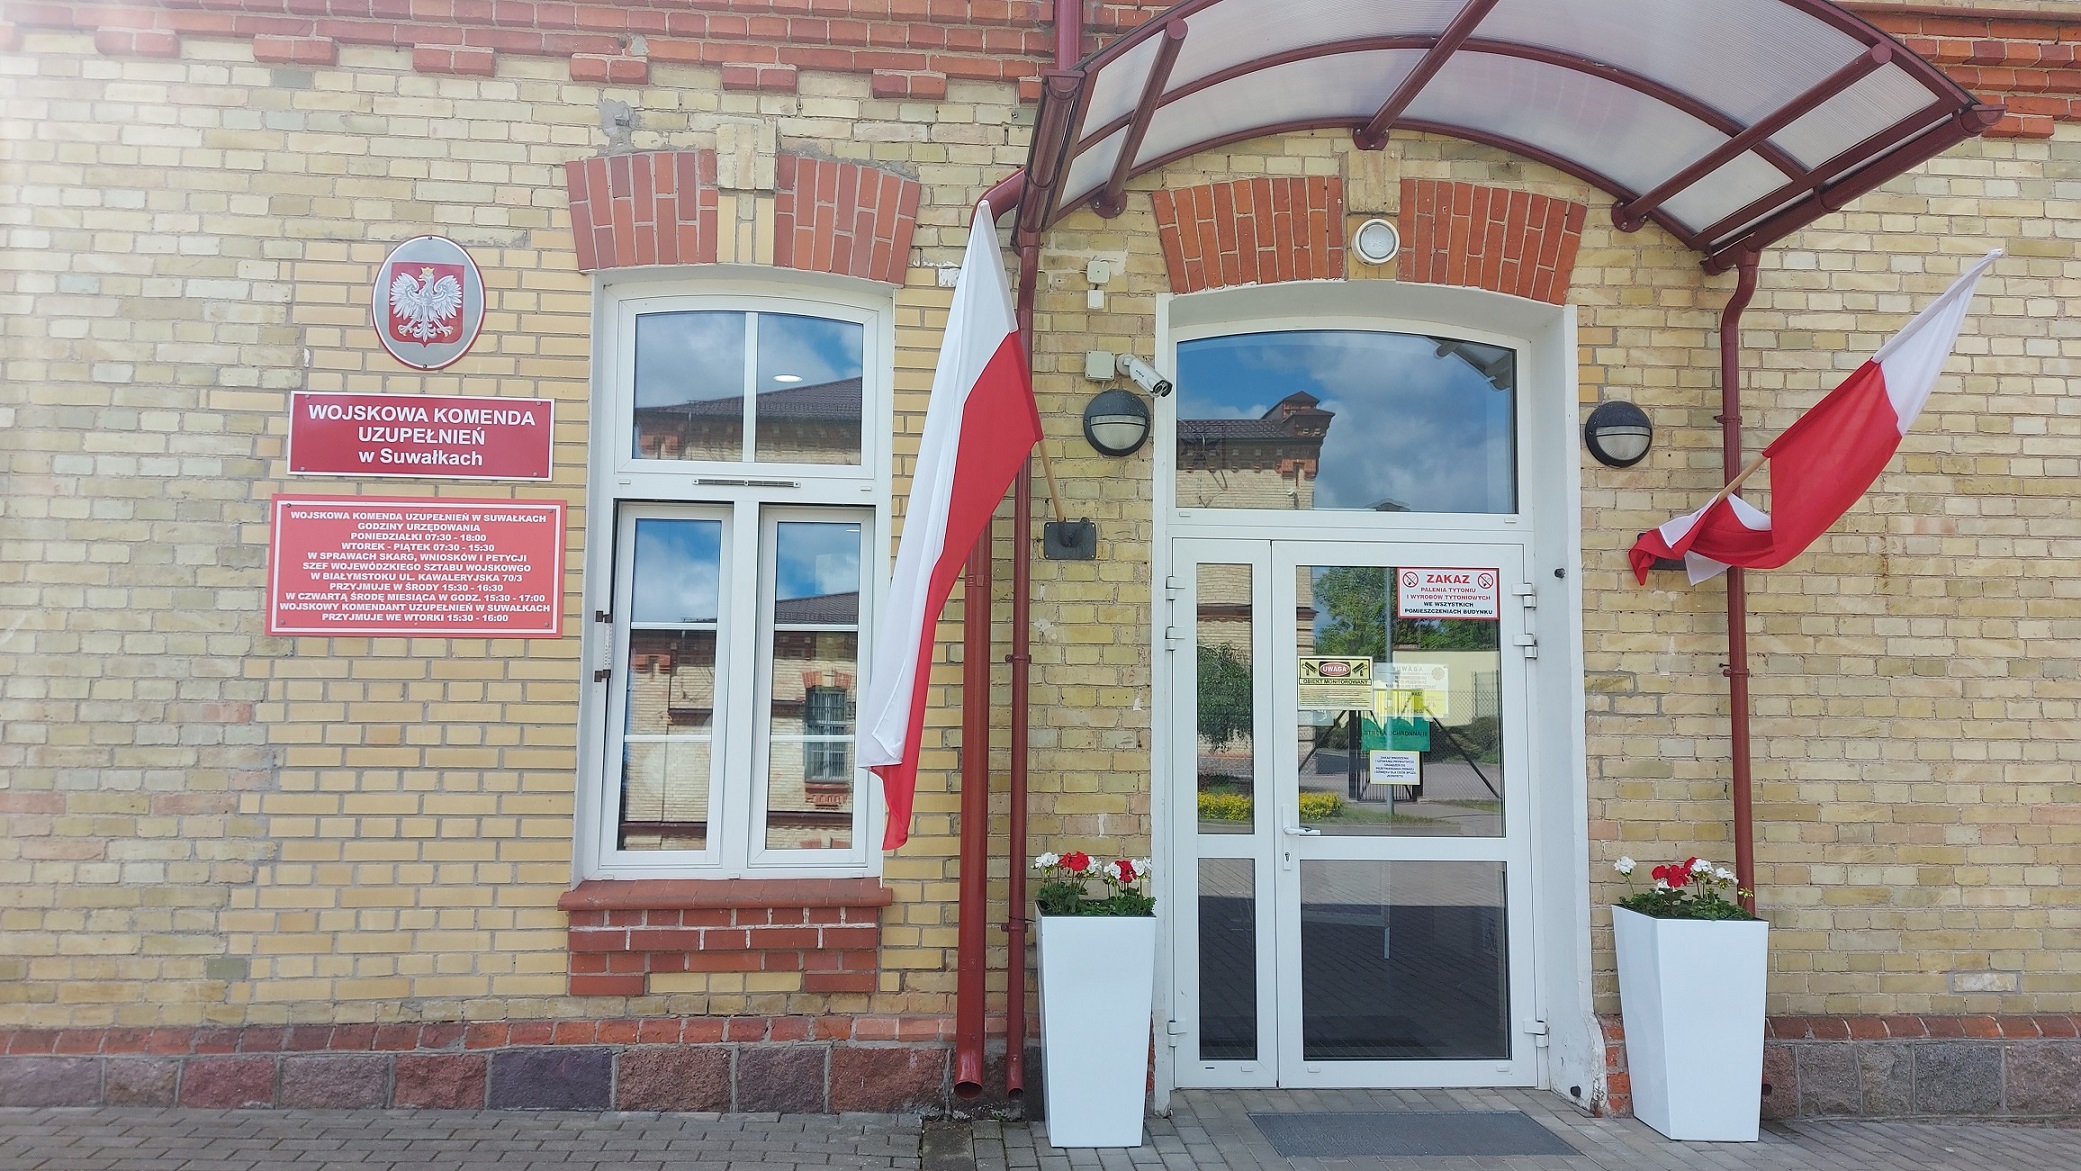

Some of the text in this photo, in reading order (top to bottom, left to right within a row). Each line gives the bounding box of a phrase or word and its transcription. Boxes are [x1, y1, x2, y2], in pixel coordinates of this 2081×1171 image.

[308, 404, 536, 425] WOJSKOWA KOMENDA
[359, 426, 484, 445] UZUPEŁNIEŃ
[359, 448, 482, 466] w Suwałkach
[291, 512, 350, 520] WOJSKOWA
[353, 512, 402, 520] KOMENDA
[406, 512, 469, 521] UZUPEŁNIEŃ
[483, 514, 546, 522] SUWAŁKACH
[406, 524, 480, 532] URZĘDOWANIA
[342, 542, 385, 550] WTOREK
[394, 544, 430, 552] PIĄTEK
[469, 544, 494, 552] 15:30
[308, 552, 318, 560] W
[380, 553, 418, 562] SKARG,
[420, 553, 476, 562] WNIOSKÓW
[486, 554, 527, 562] PETYCJI
[303, 562, 531, 572] SZEF WOJEWÓDZKIEGO SZTABU WOJSKOWGO
[418, 574, 500, 582] KAWALERYJSKA
[1427, 575, 1470, 584] ZAKAZ
[406, 582, 440, 591] ŚRODY
[286, 592, 296, 600] W
[298, 592, 348, 602] CZWARTĄ
[350, 592, 385, 602] ŚRODĘ
[388, 594, 436, 602] MIESIĄCA
[450, 594, 481, 602] GODZ.
[484, 594, 510, 602] 15:30
[280, 602, 550, 612] WOJSKOWY KOMENDANT UZUPEŁNIEŃ W SUWAŁKACH
[322, 613, 384, 621] PRZYJMUJE
[404, 614, 444, 622] WTORKI
[447, 614, 474, 622] 15:30
